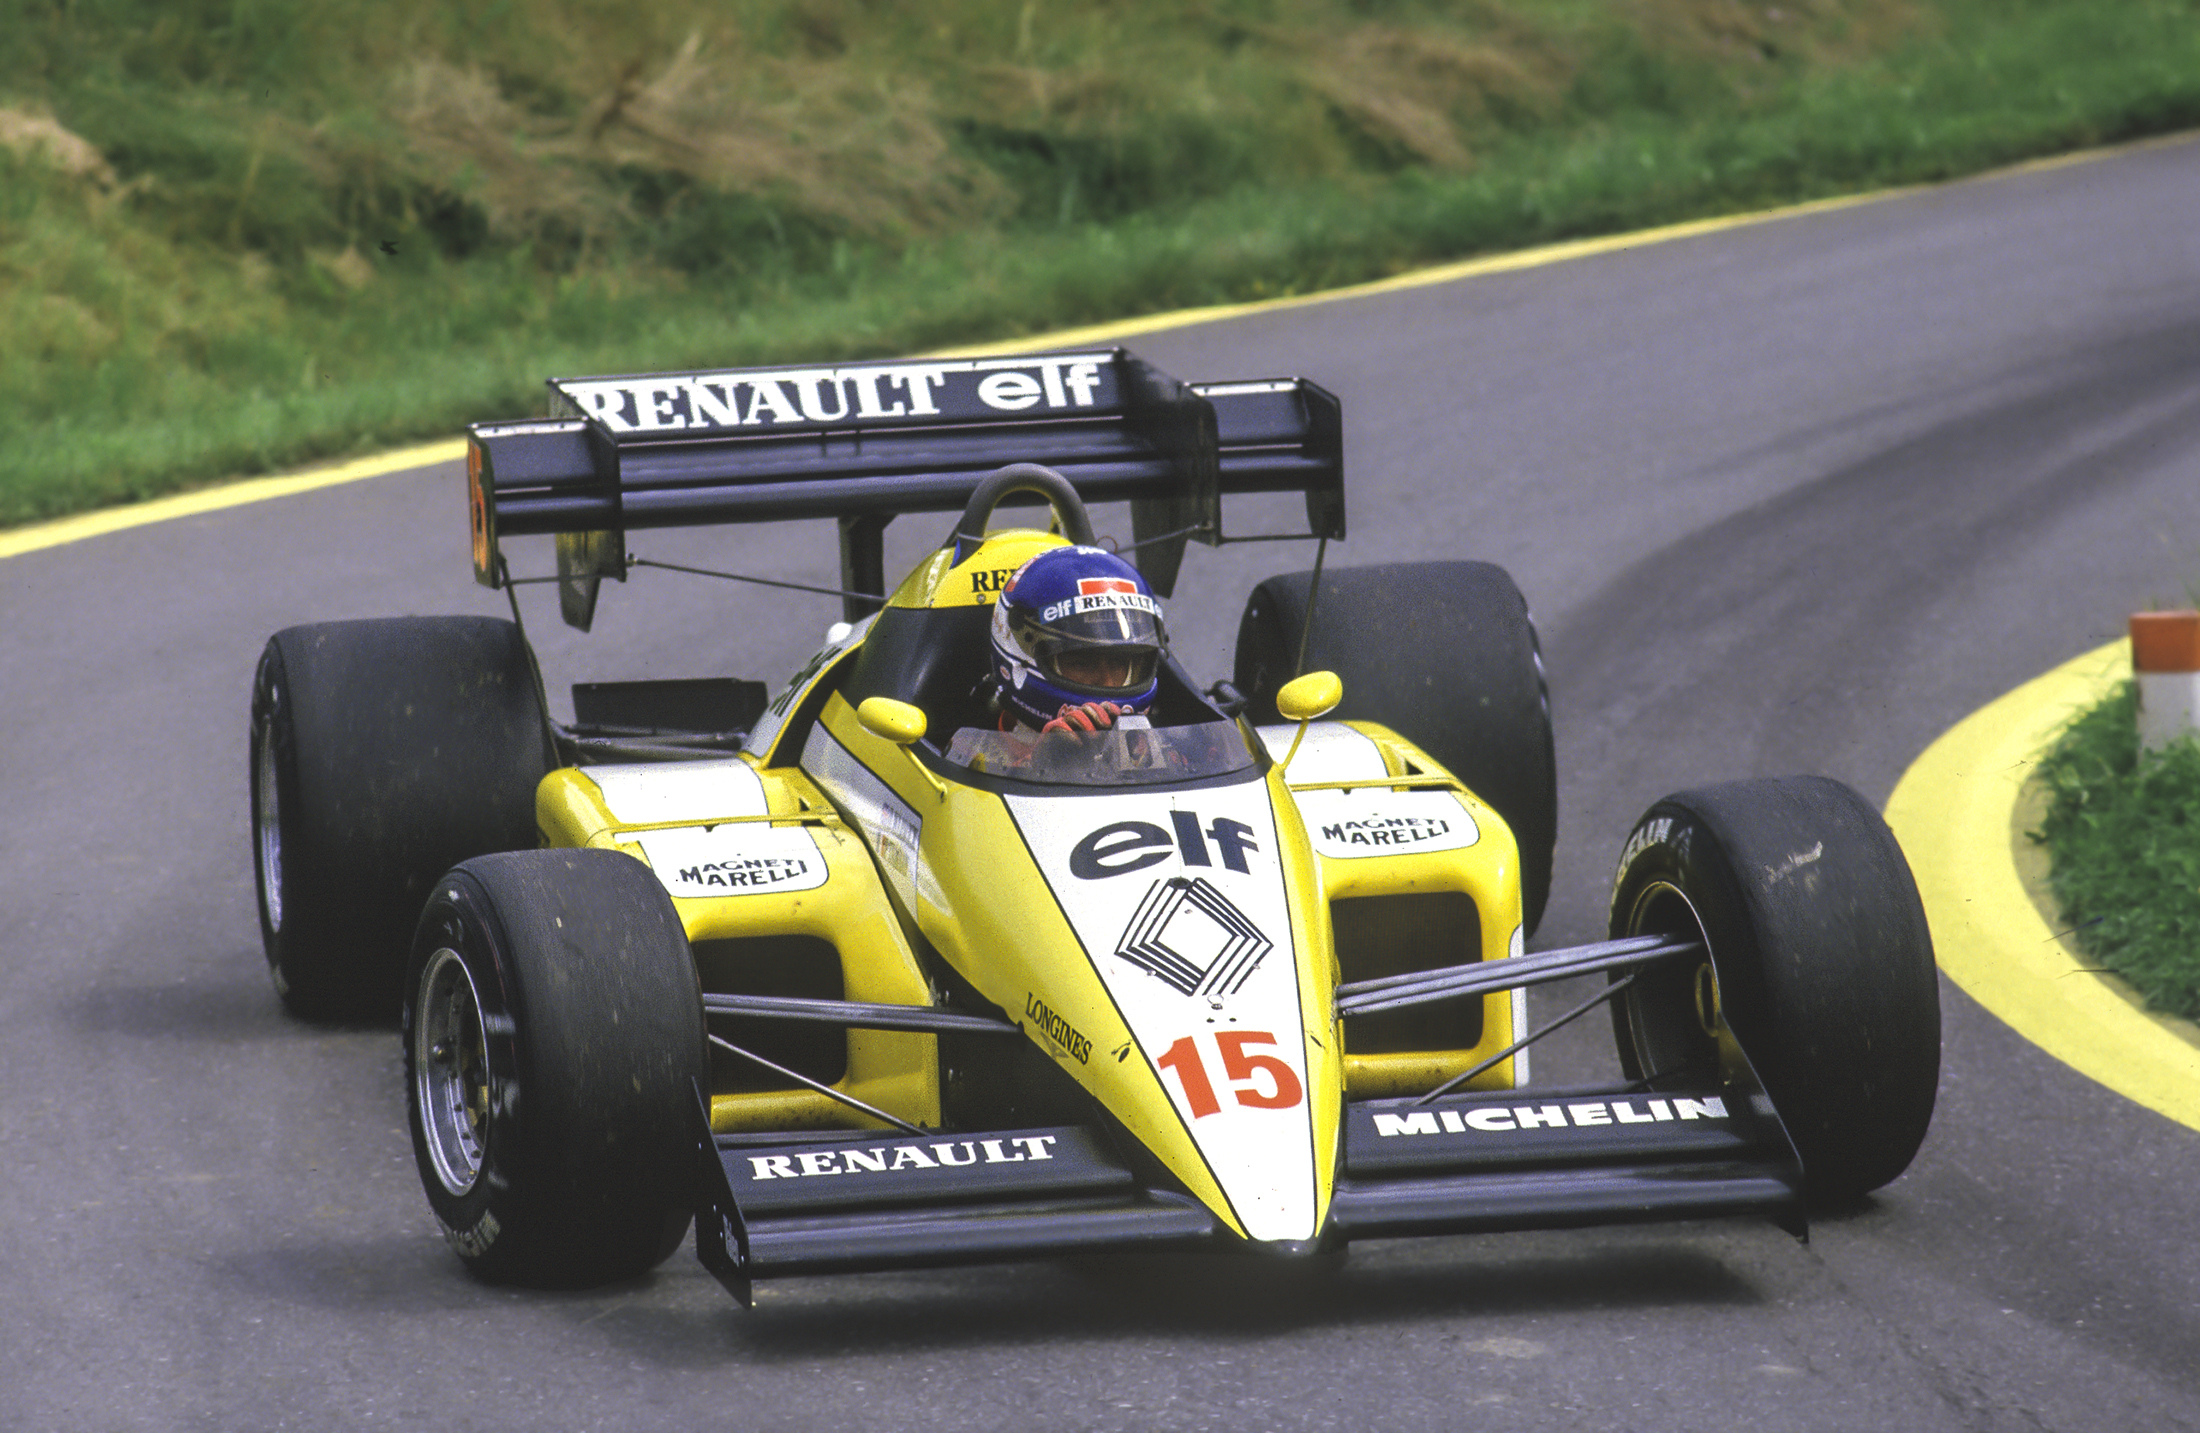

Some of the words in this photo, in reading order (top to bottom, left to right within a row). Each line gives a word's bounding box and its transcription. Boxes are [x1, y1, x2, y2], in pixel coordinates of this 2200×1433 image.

[575, 370, 945, 432] RENAULT
[977, 362, 1100, 410] elf
[1043, 599, 1072, 622] elf
[1081, 595, 1152, 611] RENAULT
[1069, 810, 1260, 881] elf
[1321, 817, 1450, 841] MAGNETI
[1321, 822, 1450, 845] MARELLI
[679, 859, 808, 881] MAGNETI
[679, 864, 808, 887] MARELLI
[1025, 991, 1092, 1065] LONGINES
[1157, 1031, 1303, 1119] 15
[1373, 1096, 1730, 1137] MICHELIN
[747, 1136, 1056, 1180] RENAULT
